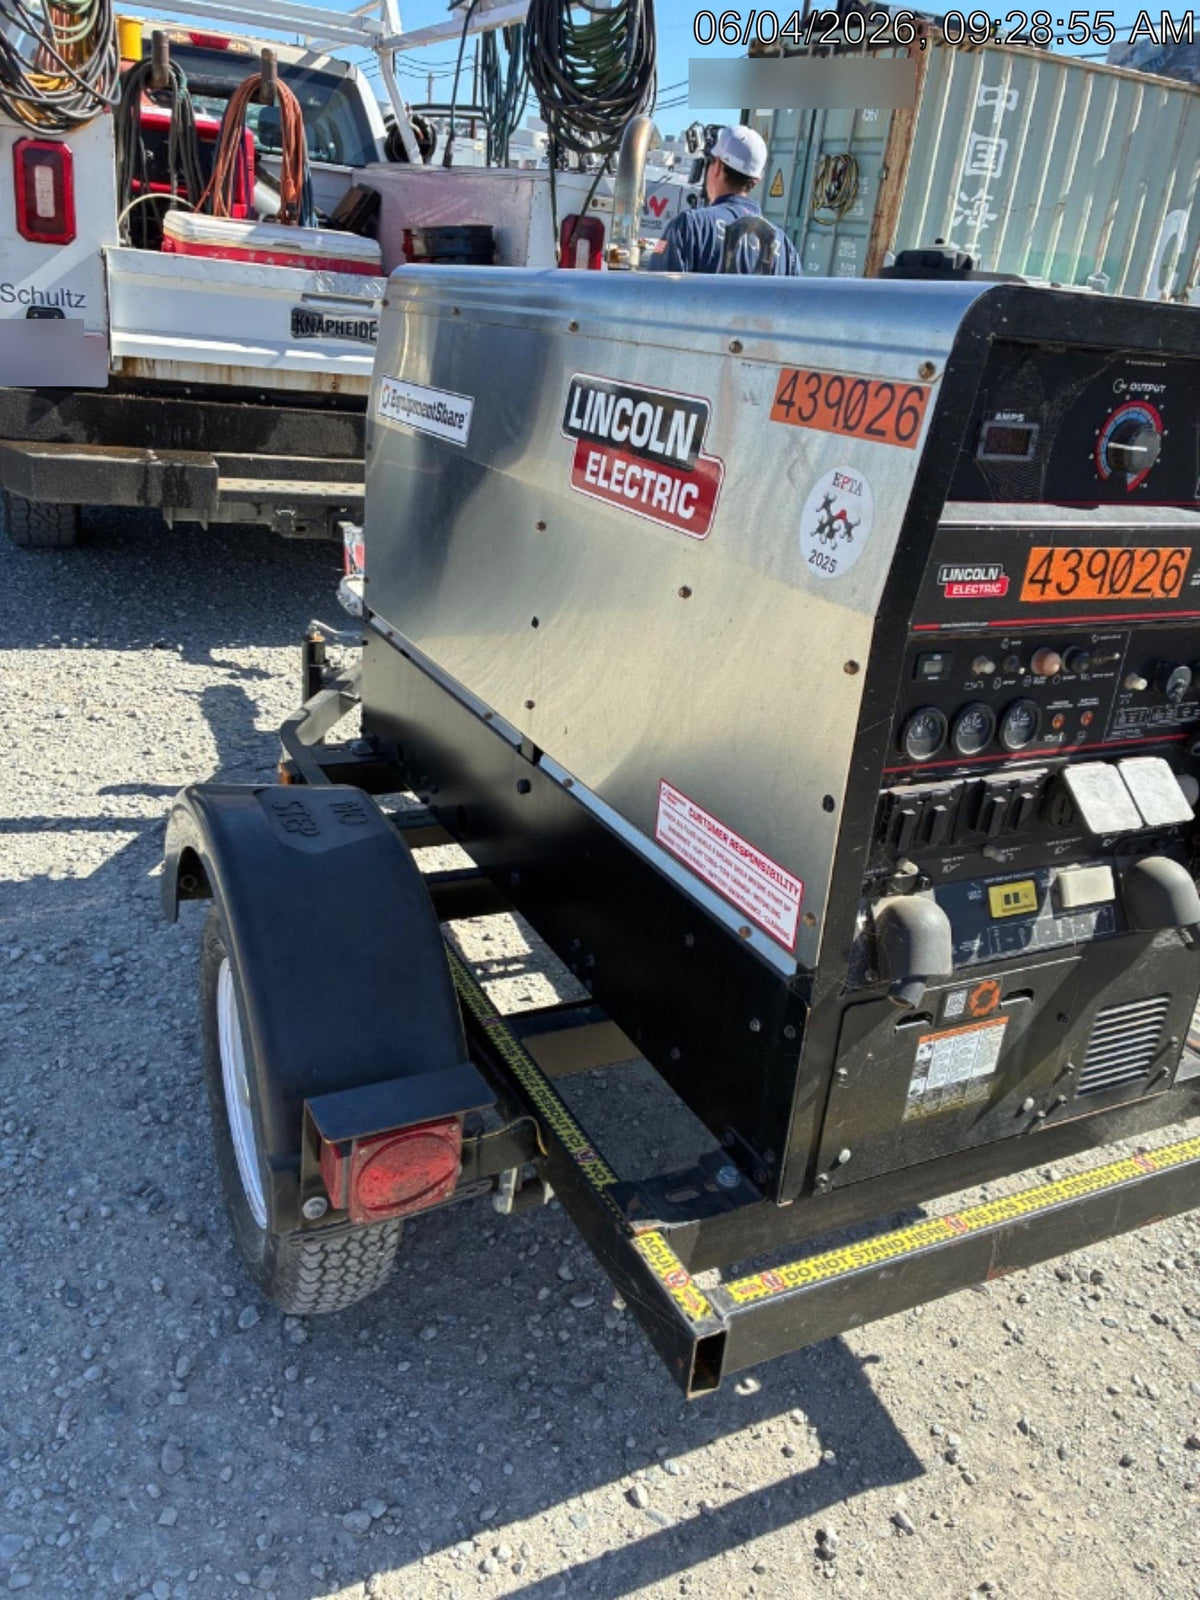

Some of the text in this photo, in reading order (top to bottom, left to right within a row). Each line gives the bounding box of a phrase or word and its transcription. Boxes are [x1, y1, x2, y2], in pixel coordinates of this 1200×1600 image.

[0, 283, 87, 308] Schultz
[294, 312, 378, 341] KNAPHEIDE
[1129, 381, 1167, 393] OUTPUT
[390, 387, 465, 430] EquipmentShare
[777, 369, 924, 441] 439026
[995, 412, 1025, 422] AMPS
[568, 386, 698, 462] LINCOLN
[584, 451, 700, 520] ELECTRIC
[831, 472, 863, 497] EPTA
[808, 549, 838, 573] 2025
[942, 567, 999, 581] LINCOLN
[1028, 548, 1187, 597] 439026
[952, 583, 1002, 595] ELECTRIC
[688, 806, 729, 845] CUSTOMER
[990, 1201, 1018, 1218] PAS
[785, 1223, 948, 1282] DO NOT STAND HERE
